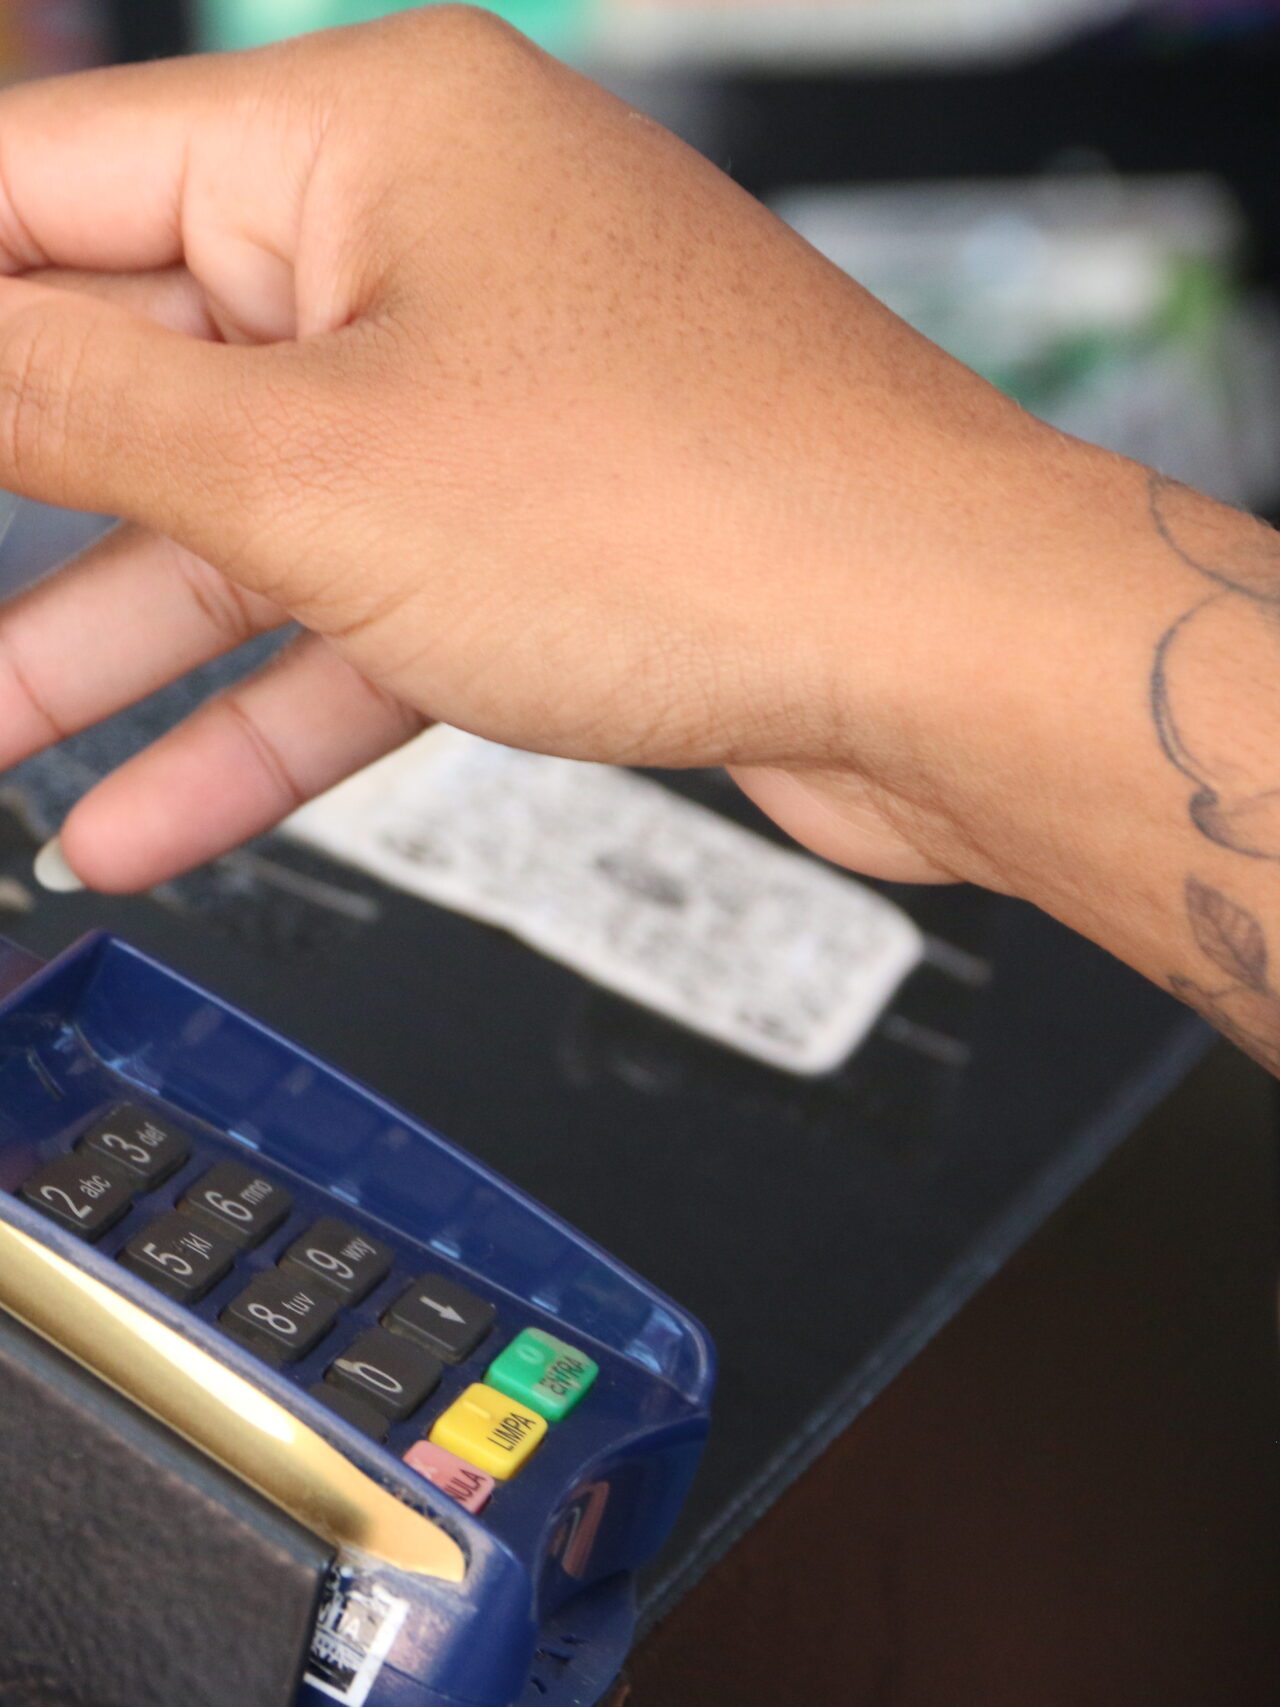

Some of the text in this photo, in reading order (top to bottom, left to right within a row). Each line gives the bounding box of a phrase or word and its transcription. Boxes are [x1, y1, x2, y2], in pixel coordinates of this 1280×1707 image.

[101, 1122, 168, 1164] 3 def
[40, 1174, 112, 1219] 2 abc
[205, 1179, 273, 1222] 6 mno
[142, 1231, 214, 1276] 5 jkl
[305, 1248, 354, 1279] 9
[247, 1291, 316, 1334] 8 tuv
[351, 1360, 403, 1393] 0
[487, 1412, 537, 1452] LIMPA
[444, 1468, 487, 1503] NULA
